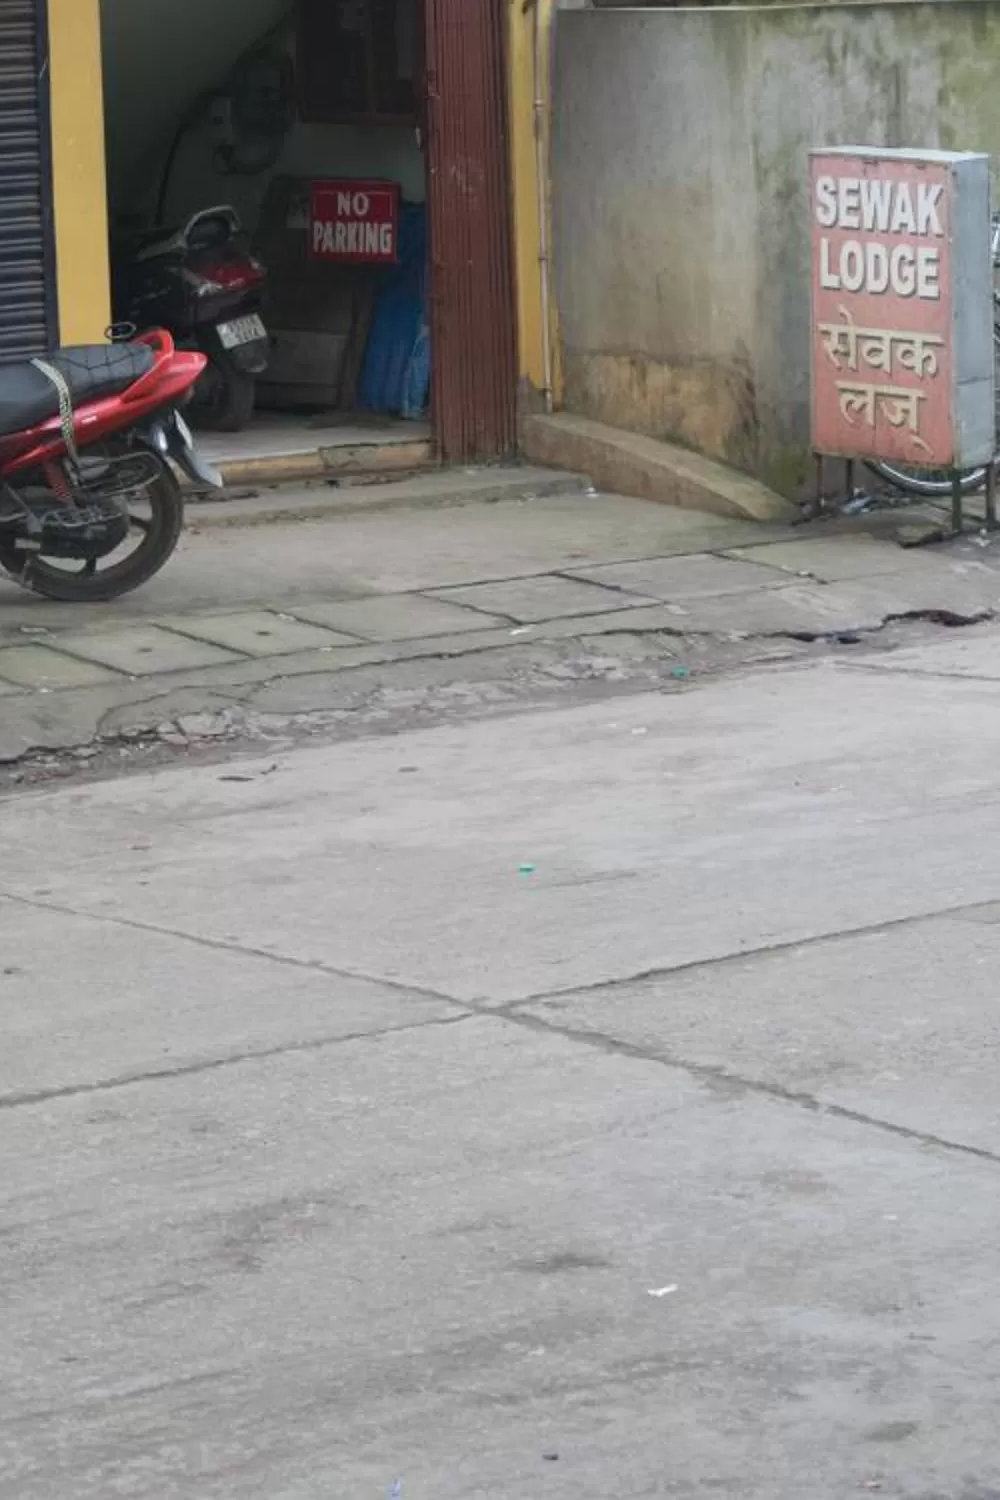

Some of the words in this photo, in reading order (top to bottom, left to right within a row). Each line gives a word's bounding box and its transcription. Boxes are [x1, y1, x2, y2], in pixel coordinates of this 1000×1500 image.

[336, 191, 369, 217] NO
[815, 175, 945, 236] SEWAK
[312, 221, 393, 254] PARKING
[819, 237, 941, 300] LODGE
[817, 303, 945, 379] सेवक
